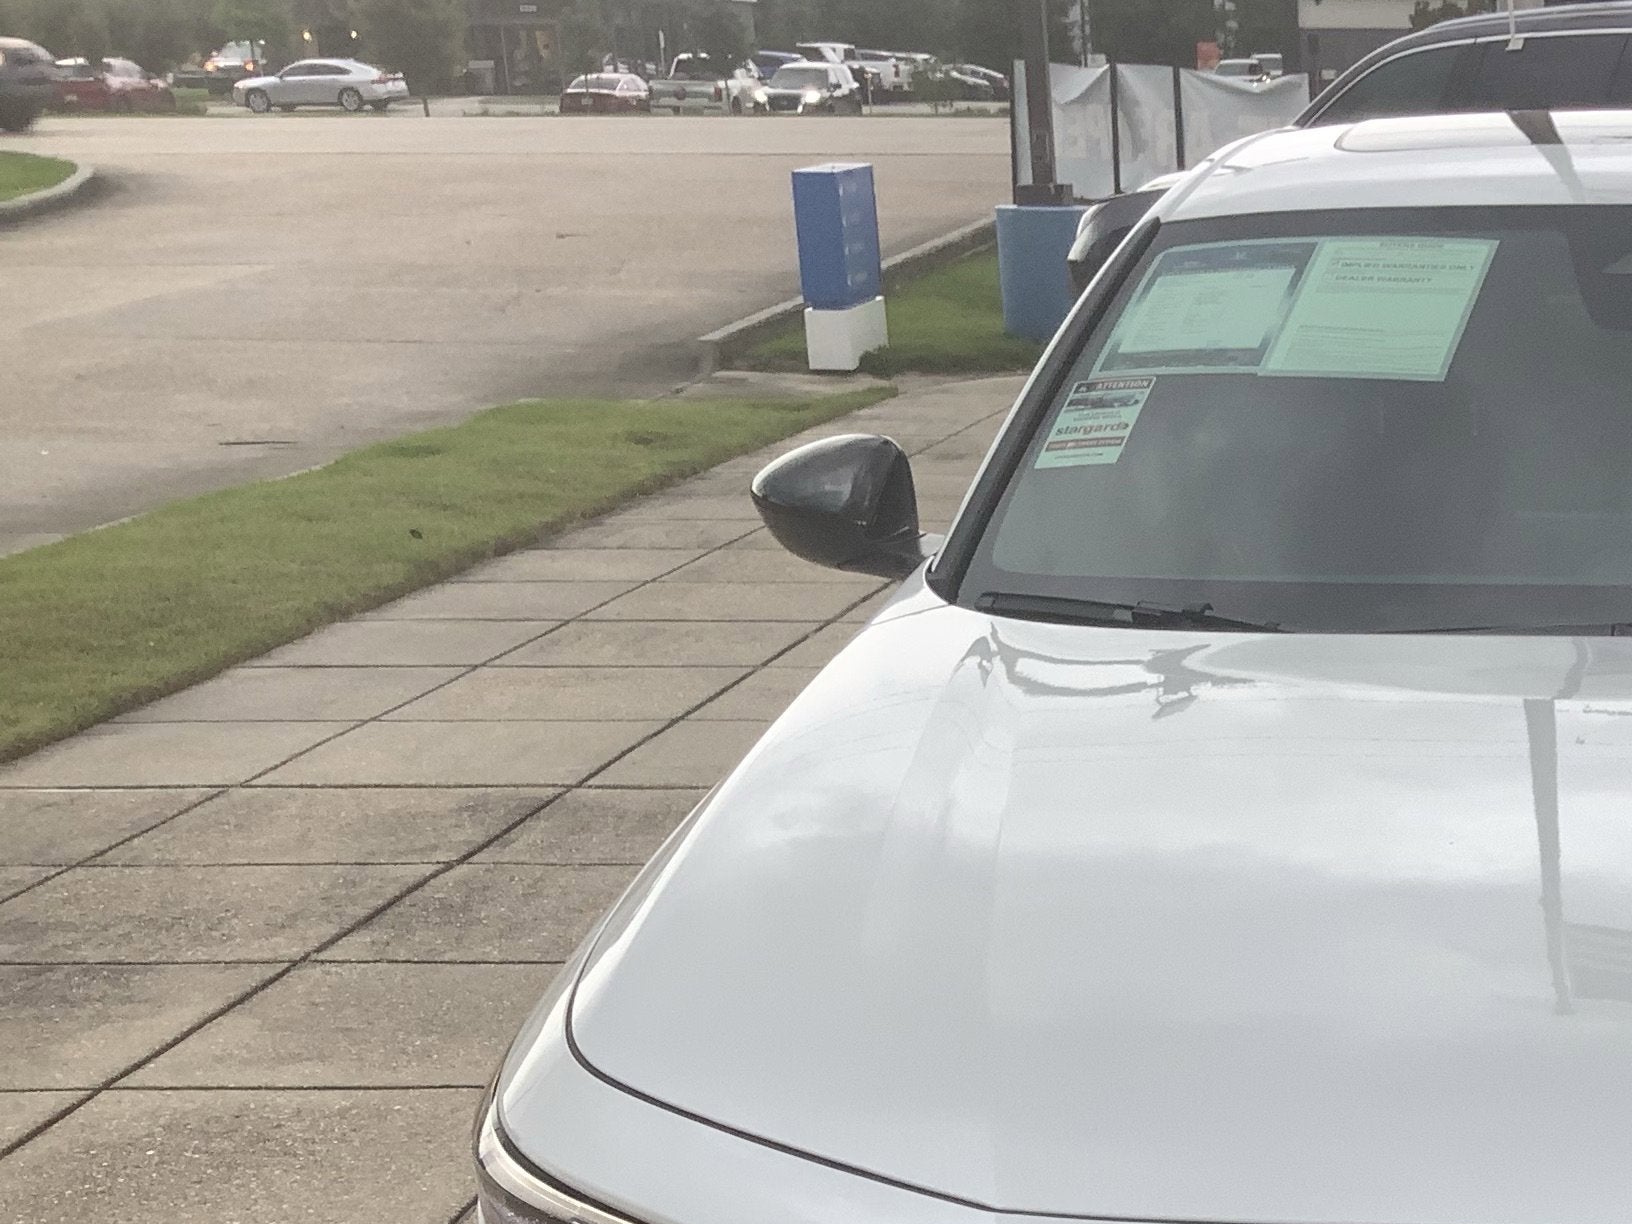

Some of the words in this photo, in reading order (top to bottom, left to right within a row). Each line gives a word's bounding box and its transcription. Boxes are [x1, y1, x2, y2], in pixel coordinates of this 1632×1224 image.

[1335, 274, 1375, 282] DEALER
[1376, 275, 1433, 283] WARRANTY
[1094, 380, 1149, 390] ATTENTION
